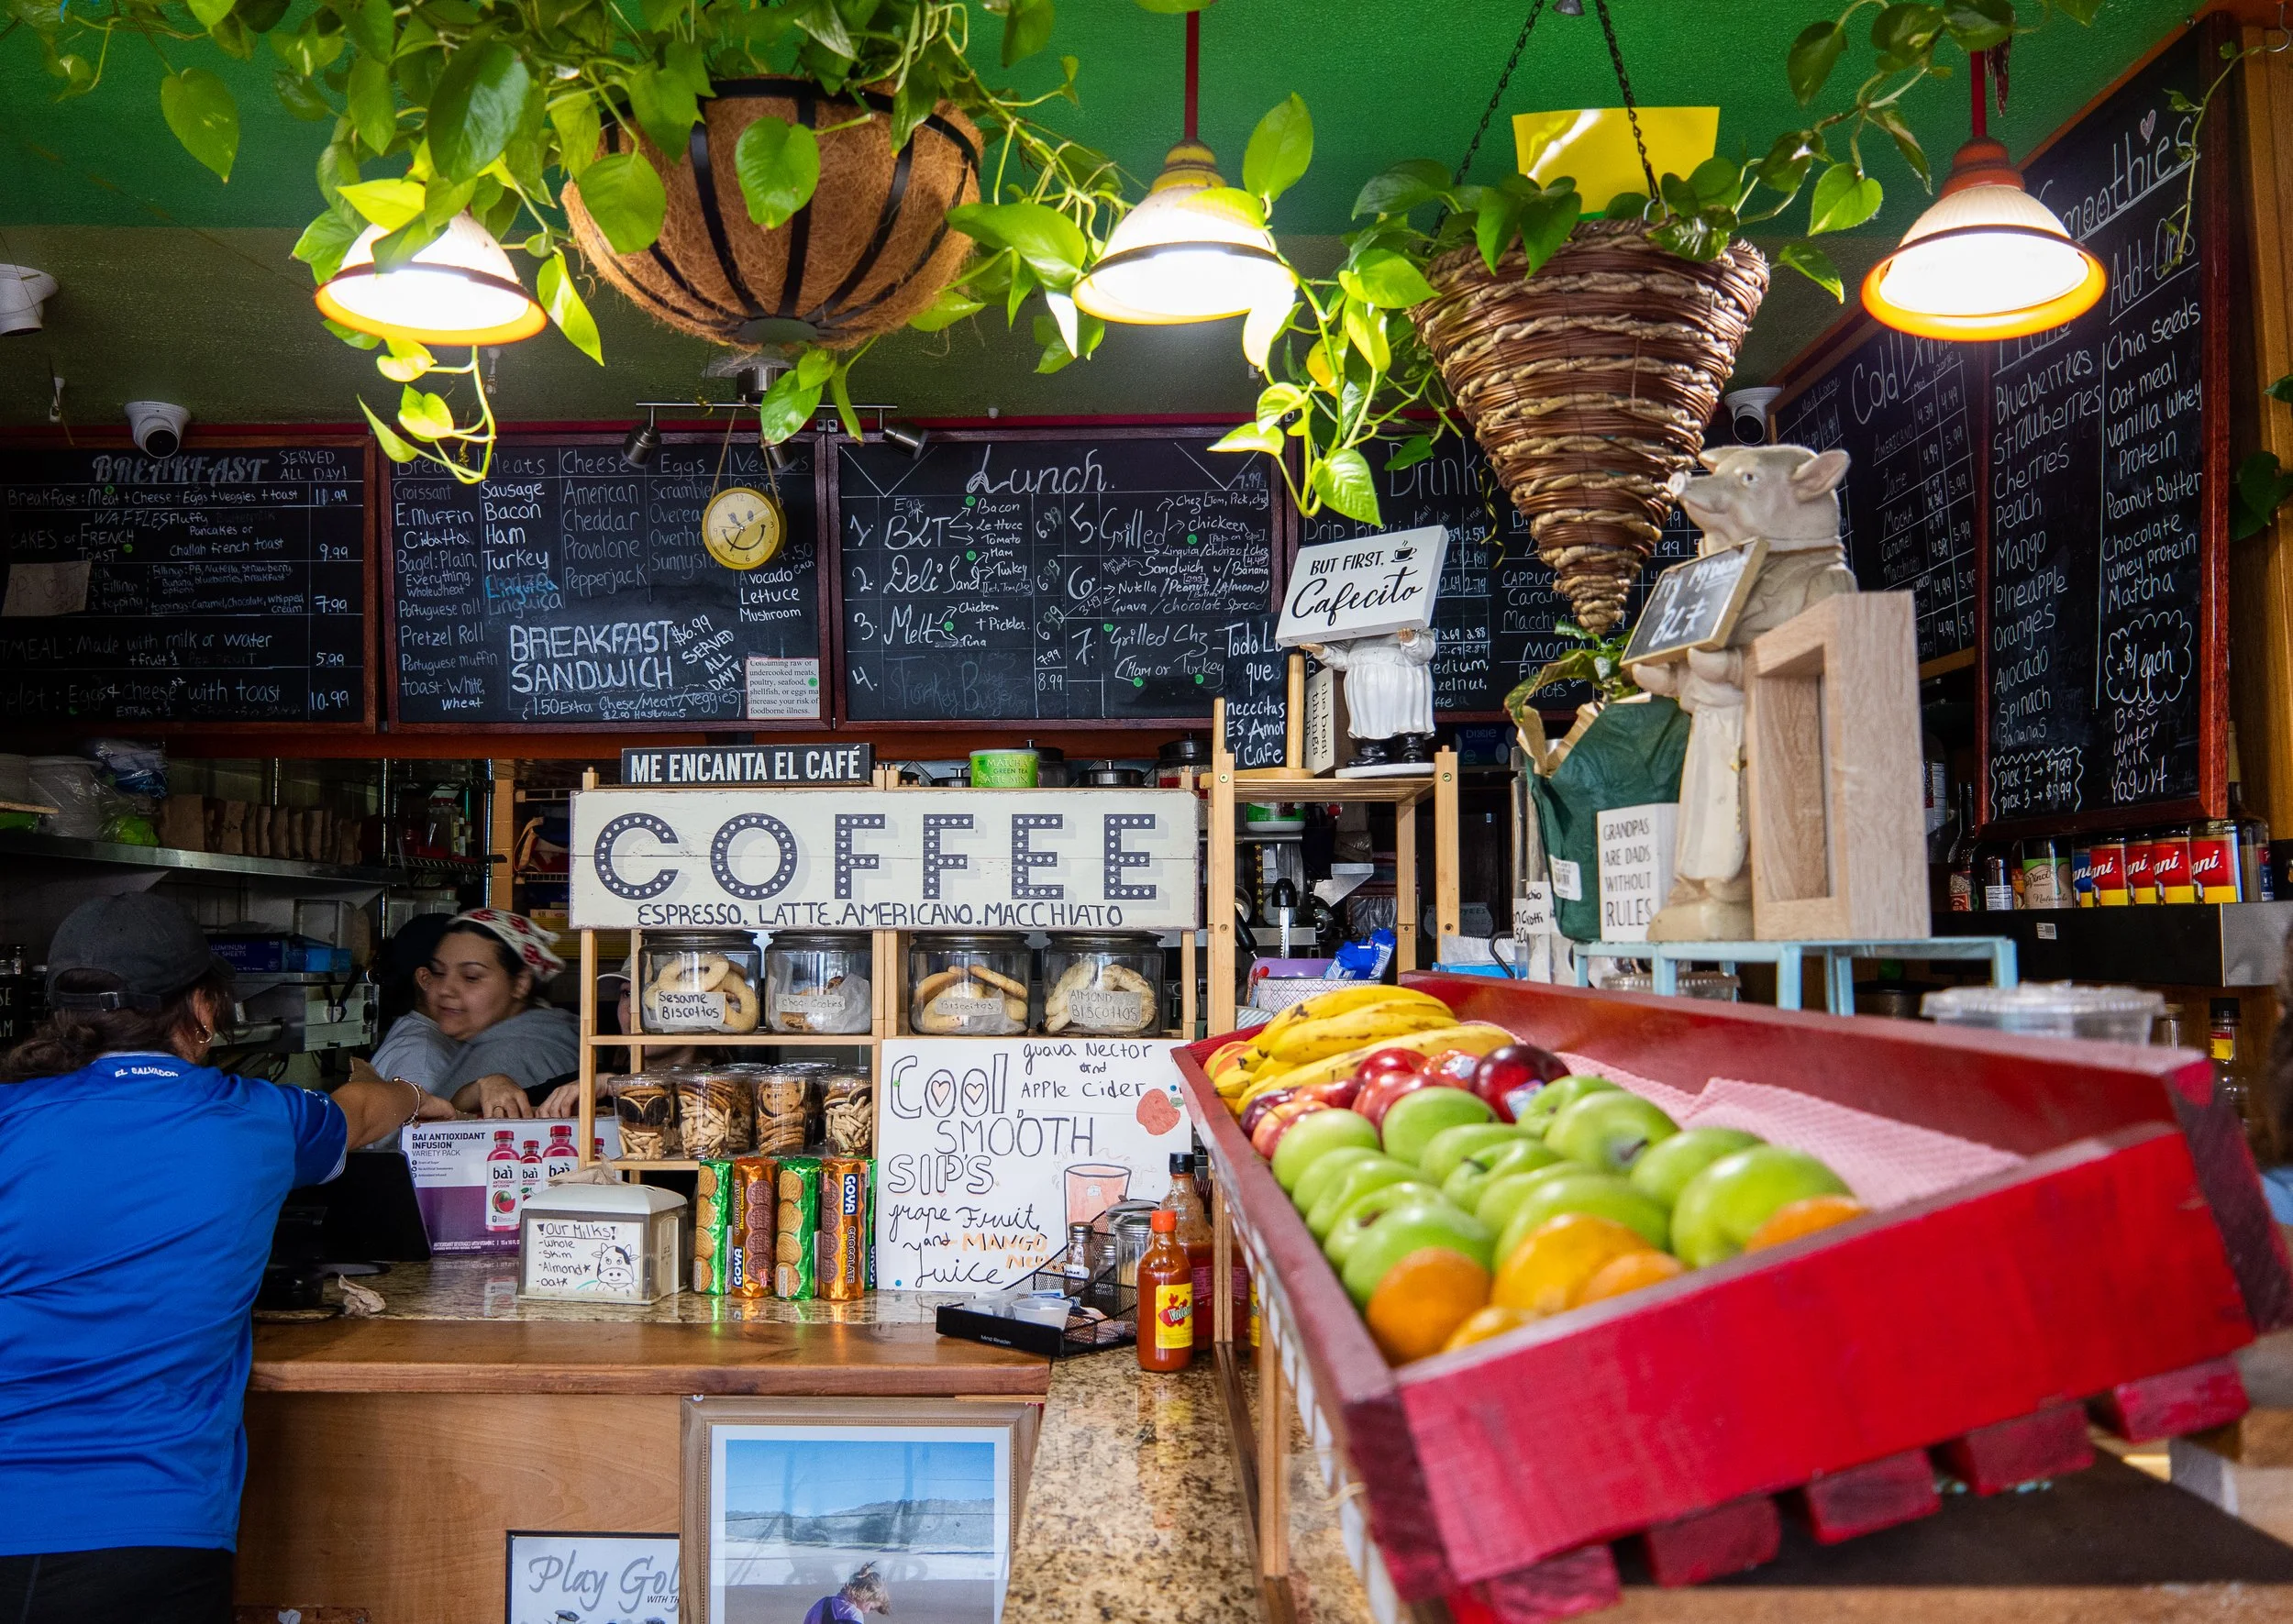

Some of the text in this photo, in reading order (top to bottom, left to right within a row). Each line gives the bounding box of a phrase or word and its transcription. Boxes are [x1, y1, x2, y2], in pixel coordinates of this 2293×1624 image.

[2107, 330, 2147, 370] Chia
[1995, 348, 2093, 425] Blueberries
[2110, 349, 2177, 415] Oat meal
[1993, 385, 2103, 466] Strawberries
[1945, 425, 1964, 451] 5.99
[279, 450, 335, 465] SERVED
[561, 451, 629, 474] Cheese
[660, 453, 705, 481] Eggs
[92, 455, 270, 487] BREAKFAST
[280, 466, 348, 482] ALL DAY!
[1993, 443, 2070, 501] Cherries
[393, 481, 452, 501] Croissant
[481, 481, 545, 502] Sausage
[563, 479, 639, 505] American
[2106, 471, 2203, 521] Peanut Butter
[484, 503, 542, 521] Bacon
[894, 498, 925, 517] Egg
[976, 496, 1020, 514] Bacon
[95, 510, 208, 531] WAFFLES Fluffy
[190, 525, 253, 536] Pancakes or
[562, 510, 640, 532] Cheddar
[884, 515, 951, 550] BLT
[1100, 507, 1169, 552] Grilled
[81, 523, 135, 546] FRENCH
[170, 536, 284, 557] Challah toast
[485, 525, 526, 545] Ham
[980, 534, 1022, 545] Tomato
[1881, 530, 1913, 563] Caramel
[2102, 514, 2183, 563] Chocolate
[77, 547, 118, 563] TOAST
[319, 543, 349, 561] 9.99
[564, 535, 640, 560] Provolone
[990, 548, 1013, 558] Ham
[1995, 530, 2047, 578] Mango
[482, 550, 548, 572] Turkey
[793, 559, 815, 576] each
[992, 561, 1027, 580] Turkey
[1138, 556, 1203, 577] Sandwich
[1309, 550, 1384, 576] BUT FIRST,
[565, 563, 648, 597] Pepperjack
[739, 569, 793, 587] Avocado
[882, 555, 943, 593] Deli
[740, 585, 801, 605] Lettuce
[1118, 580, 1158, 595] Nutella
[1291, 566, 1423, 627] Cafecito
[2107, 571, 2175, 614] Matcha
[271, 604, 303, 613] cream
[315, 595, 348, 613] 7.99
[399, 597, 482, 621] Portuguese roll
[739, 606, 802, 623] Mushroom
[1111, 598, 1146, 616] Guava
[401, 622, 484, 646] Pretzel Roll
[670, 614, 714, 646] $6.99
[883, 603, 935, 646] Melt
[77, 628, 215, 654] Made with milk or
[510, 619, 674, 661] BREAKFAST
[681, 629, 735, 664] SERVED
[960, 635, 987, 647] Tuna
[1109, 623, 1169, 661] Grilled
[1224, 622, 1258, 658] Todo
[316, 652, 345, 666] 5.99
[402, 651, 498, 677] Portuguese muffin
[704, 653, 733, 674] ALL
[1036, 648, 1061, 666] 7.99
[1155, 654, 1225, 681] or Turkey
[512, 656, 673, 693] SANDWICH
[1037, 672, 1063, 691] 8.99
[1246, 662, 1274, 697] que
[1993, 646, 2049, 695] Avocado
[188, 679, 281, 703] with toast
[749, 679, 776, 687] poultry,
[749, 688, 781, 696] shellfish,
[310, 690, 349, 711] 10.99
[560, 700, 593, 714] Extra
[1226, 695, 1286, 719] nececitas
[1247, 718, 1286, 744] Amor
[1312, 690, 1320, 756] things
[630, 745, 861, 783] ME ENCANTA EL CAFÉ
[986, 758, 1028, 768] MATCHA
[2111, 755, 2168, 804] Yogurt
[1602, 817, 1650, 842] GRANDPAS
[593, 812, 1158, 900] COFFEE
[1603, 845, 1652, 867] ARE DADS
[1604, 871, 1652, 893] WITHOUT
[1606, 897, 1653, 928] RULES
[659, 990, 707, 1004] Sesame
[115, 1066, 179, 1077] EL SALVADOR
[1023, 1043, 1078, 1076] guava
[890, 1054, 1009, 1119] Cool
[412, 1142, 453, 1150] INFUSION
[428, 1132, 486, 1141] ANTIOXIDANT
[934, 1113, 1094, 1158] SMOOTH
[844, 1174, 858, 1215] GOYA
[888, 1203, 952, 1243] grape
[847, 1225, 857, 1284] CHOCOLATE
[962, 1232, 1049, 1253] MANGO
[734, 1247, 744, 1288] GOYA
[528, 1549, 680, 1614] Play Gol
[647, 1595, 668, 1604] WITH
